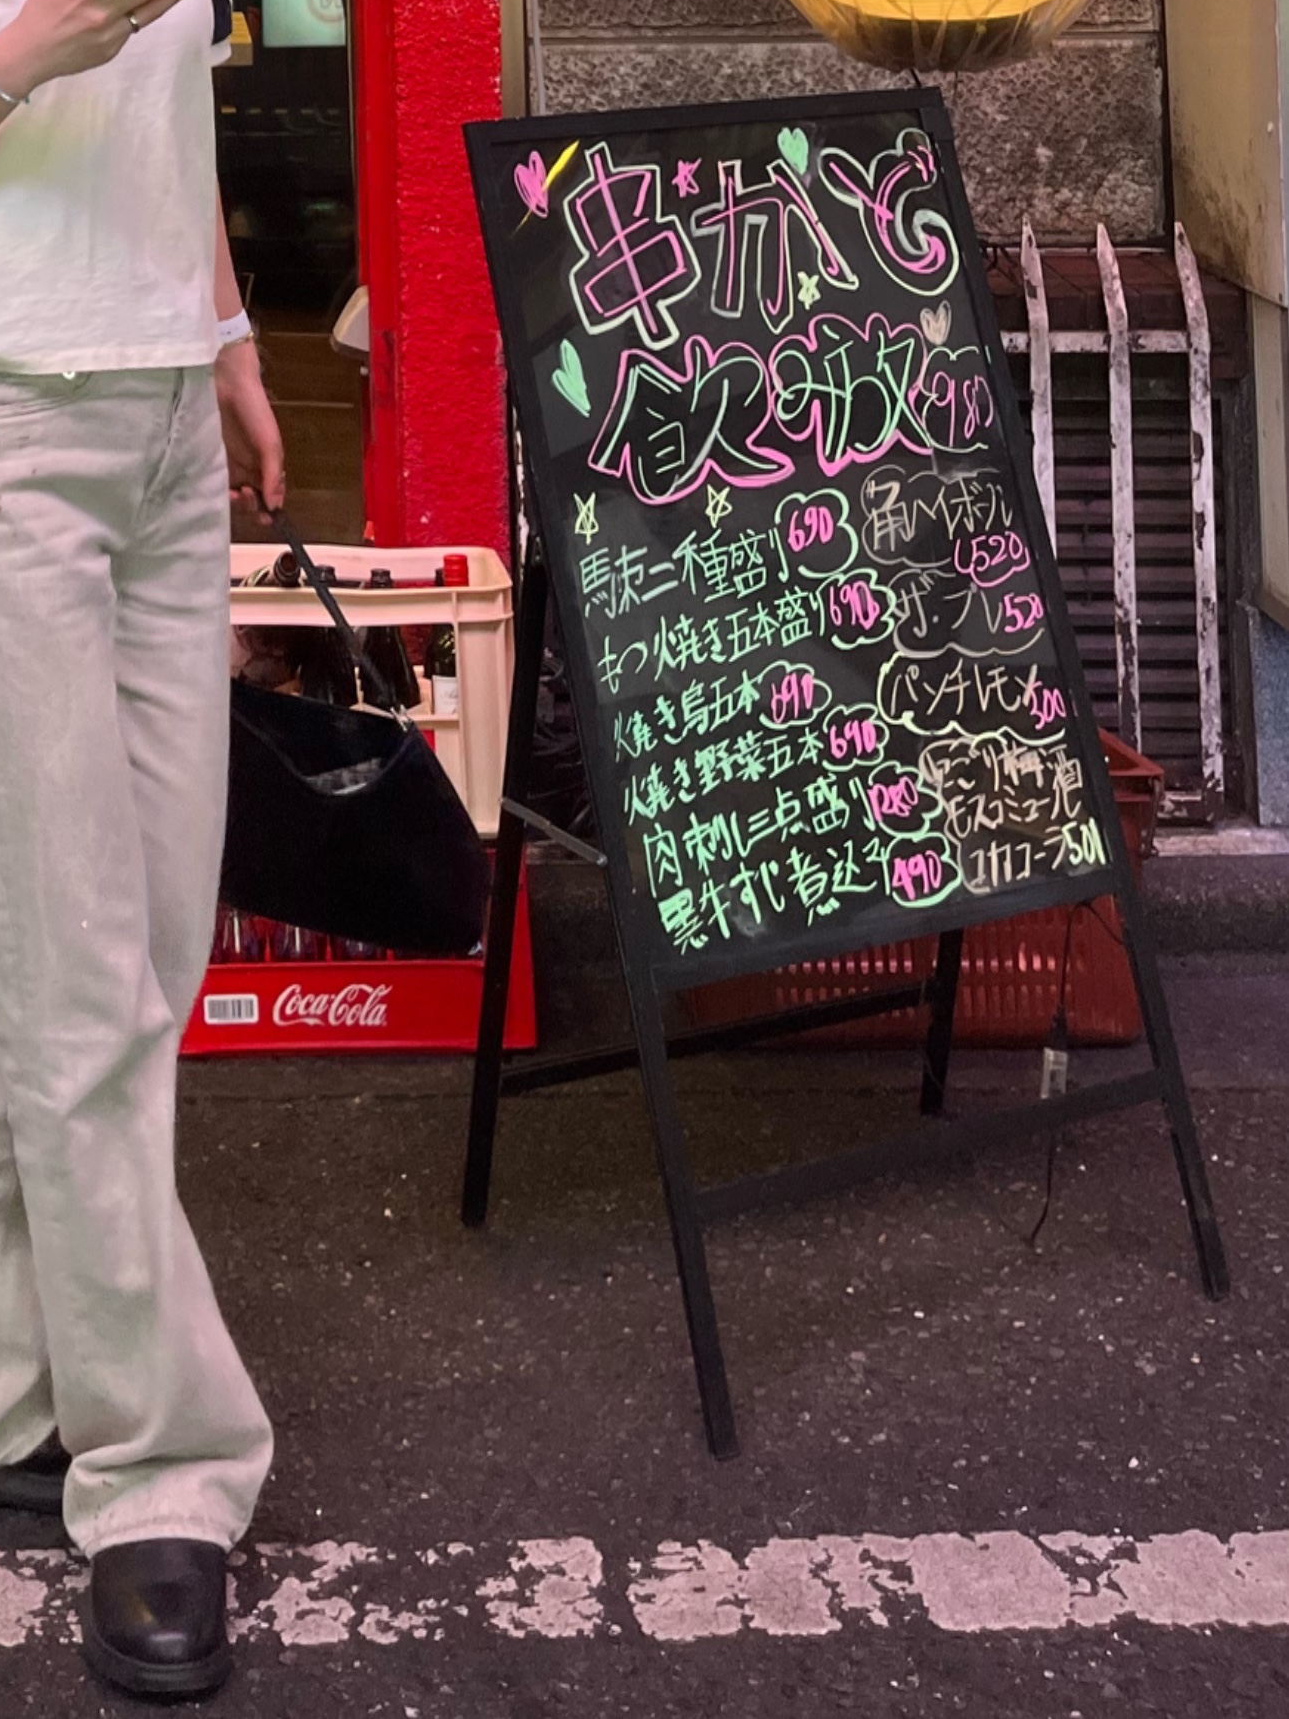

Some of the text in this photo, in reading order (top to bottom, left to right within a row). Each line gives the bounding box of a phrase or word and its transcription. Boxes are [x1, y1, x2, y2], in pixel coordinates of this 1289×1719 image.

[563, 129, 960, 351] 串かど
[786, 505, 835, 553] 690
[828, 719, 877, 760] 690
[890, 849, 943, 901] 490
[272, 984, 393, 1027] Coca-Cola
